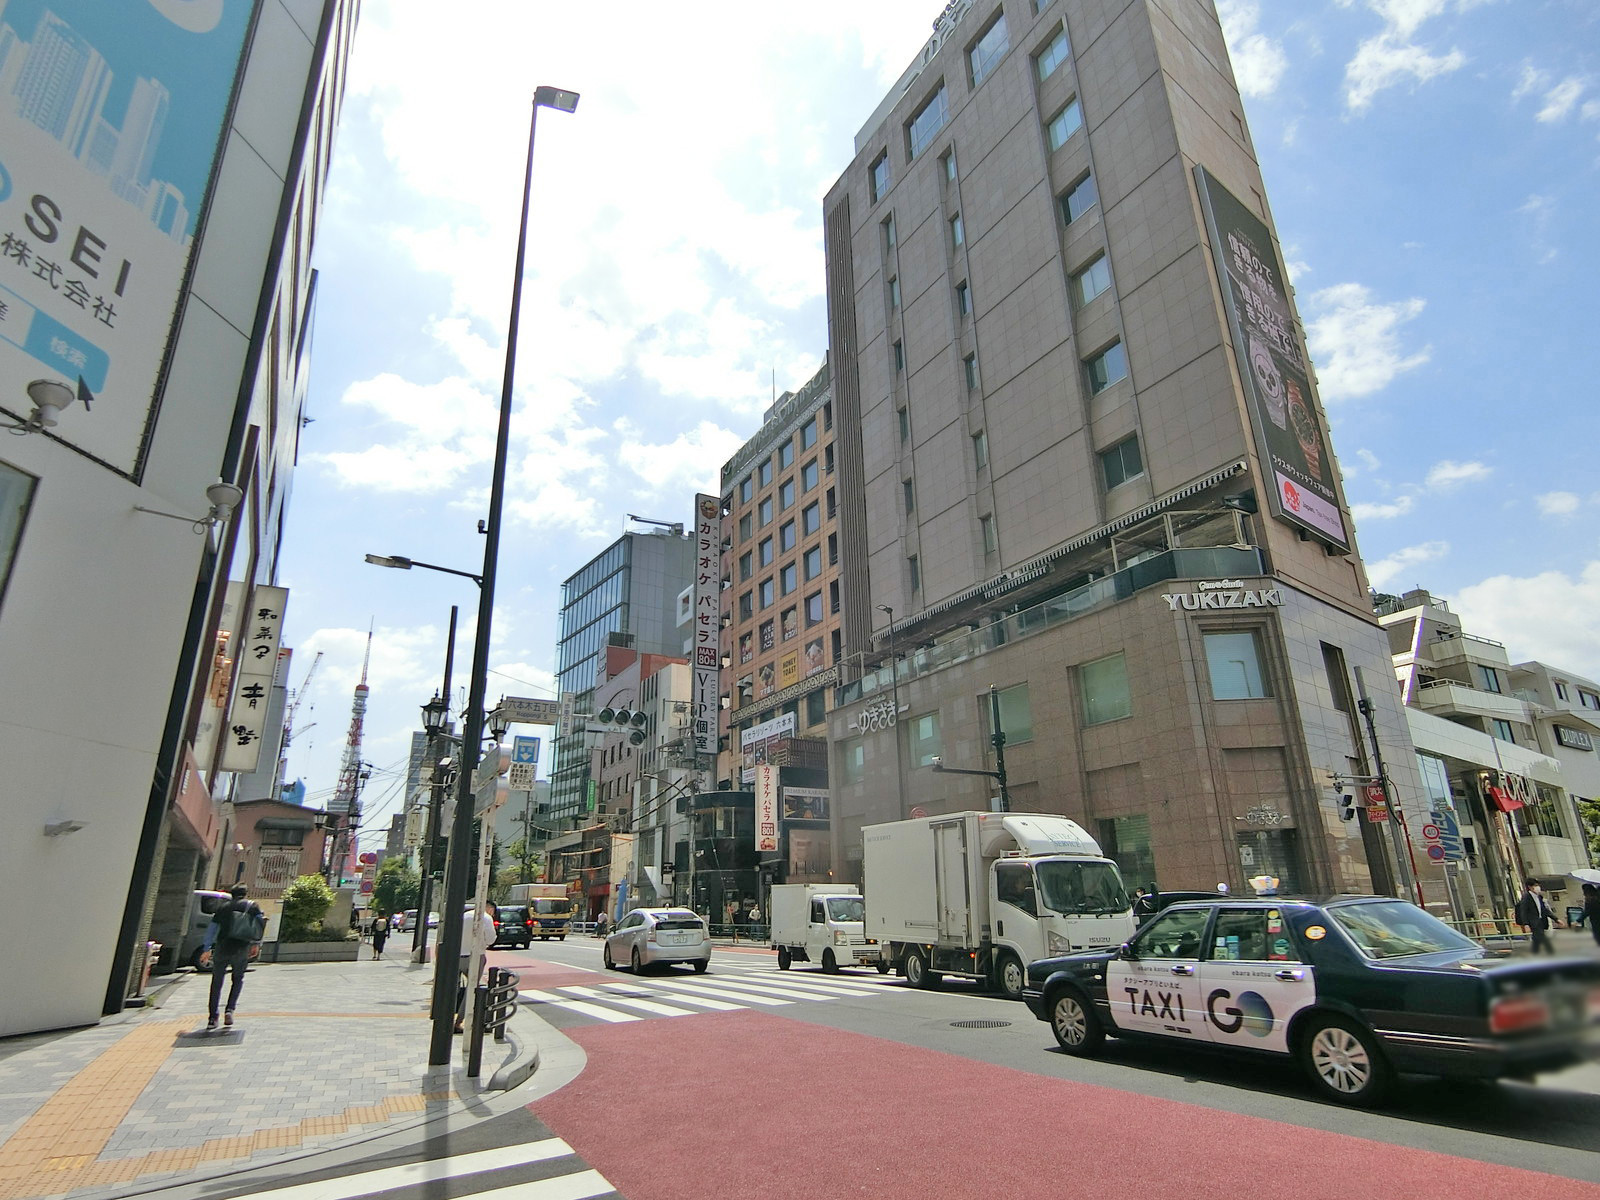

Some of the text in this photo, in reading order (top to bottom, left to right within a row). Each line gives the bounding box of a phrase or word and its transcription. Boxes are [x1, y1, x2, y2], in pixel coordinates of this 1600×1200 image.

[1, 232, 117, 329] 株式会社
[698, 523, 711, 643] カラオケ パセラ
[1161, 589, 1286, 611] YUKIZAKI
[698, 647, 715, 657] MAX
[508, 700, 557, 714] 六本木五丁目
[696, 672, 709, 750] VIP個室
[1560, 728, 1591, 748] DUPLEX
[763, 766, 771, 798] カラオケ
[762, 800, 772, 821] パセラ
[1426, 828, 1436, 836] 40
[1125, 987, 1185, 1022] TAXI
